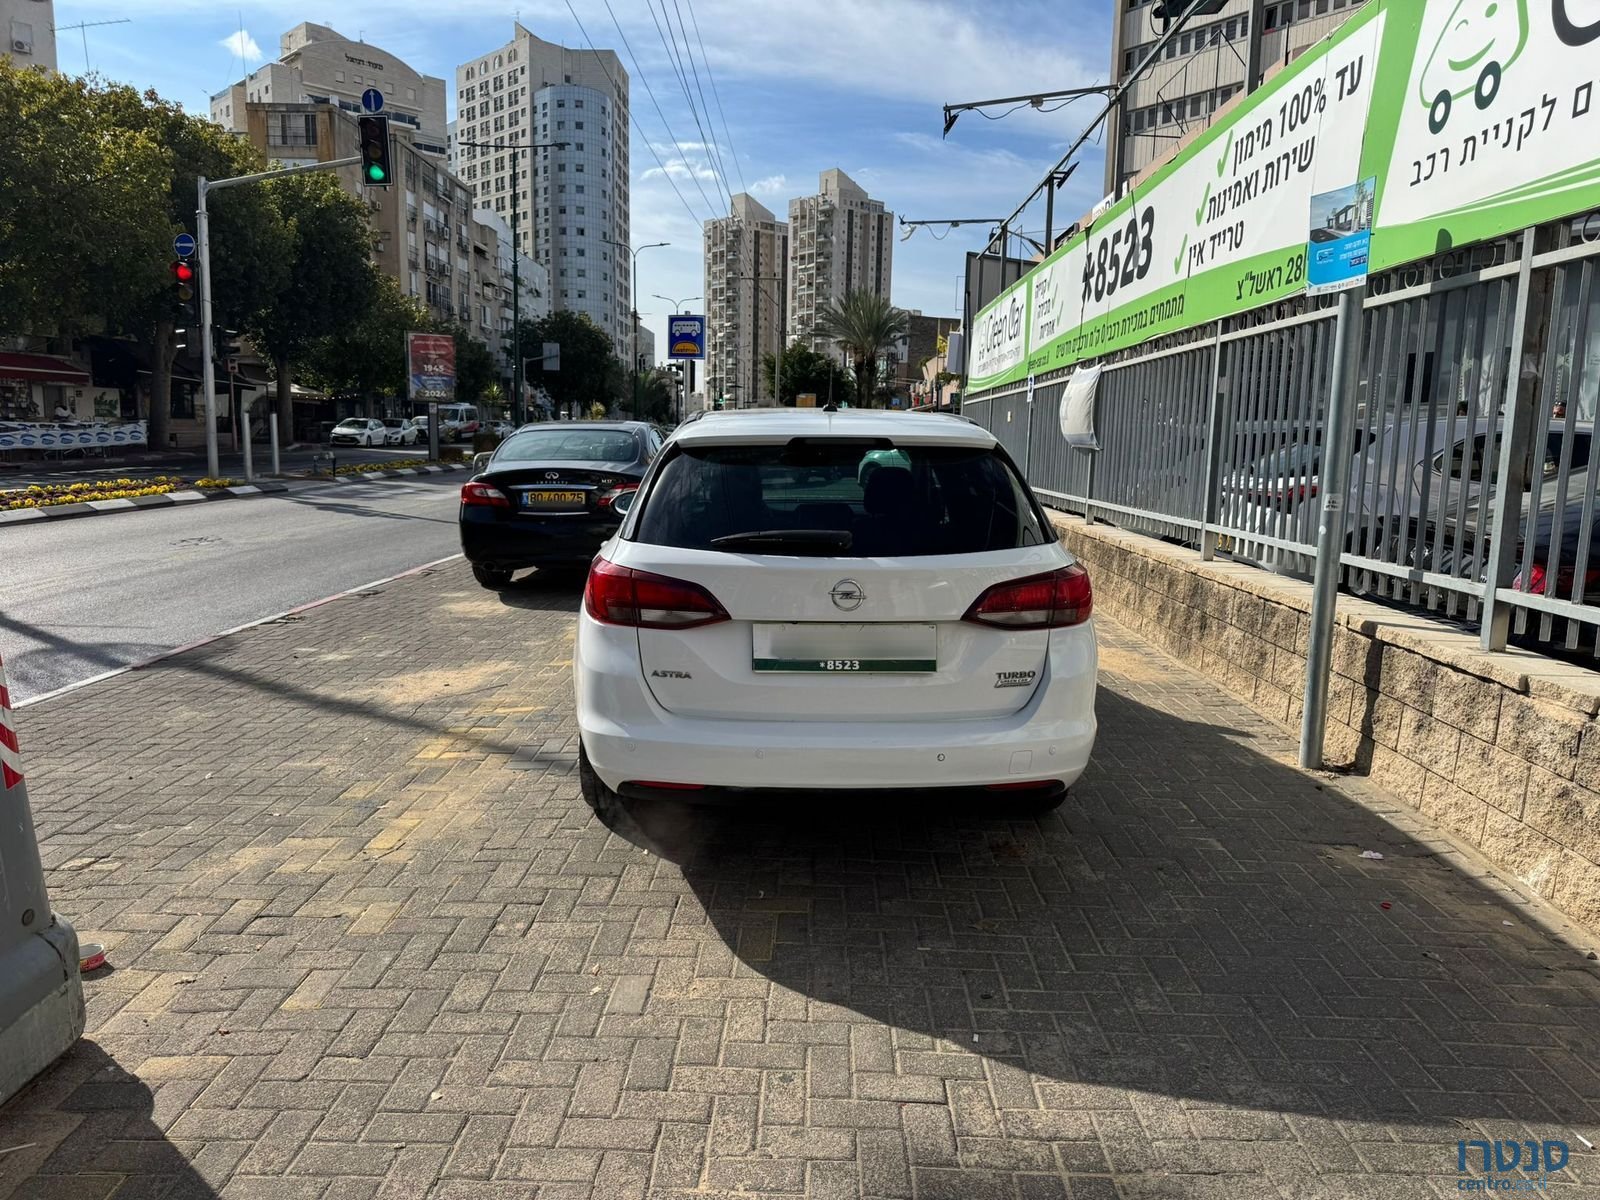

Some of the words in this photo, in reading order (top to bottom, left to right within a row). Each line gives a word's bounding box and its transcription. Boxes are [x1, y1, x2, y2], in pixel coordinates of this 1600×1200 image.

[1335, 55, 1363, 102] עד
[1280, 78, 1326, 138] 100%
[1233, 118, 1272, 176] מימון
[1460, 93, 1557, 166] לקניית
[1262, 136, 1315, 194] שירות
[1410, 147, 1449, 187] רכב
[1207, 169, 1259, 224] ואמינות
[1187, 238, 1206, 278] אין
[1210, 220, 1244, 260] טרייד
[1285, 253, 1304, 285] 28
[1009, 297, 1024, 341] Car
[1120, 308, 1148, 337] במכירת
[1150, 294, 1185, 326] מתמחים
[423, 364, 445, 372] 1945
[651, 670, 692, 680] ASTRA
[995, 670, 1036, 680] TURBO
